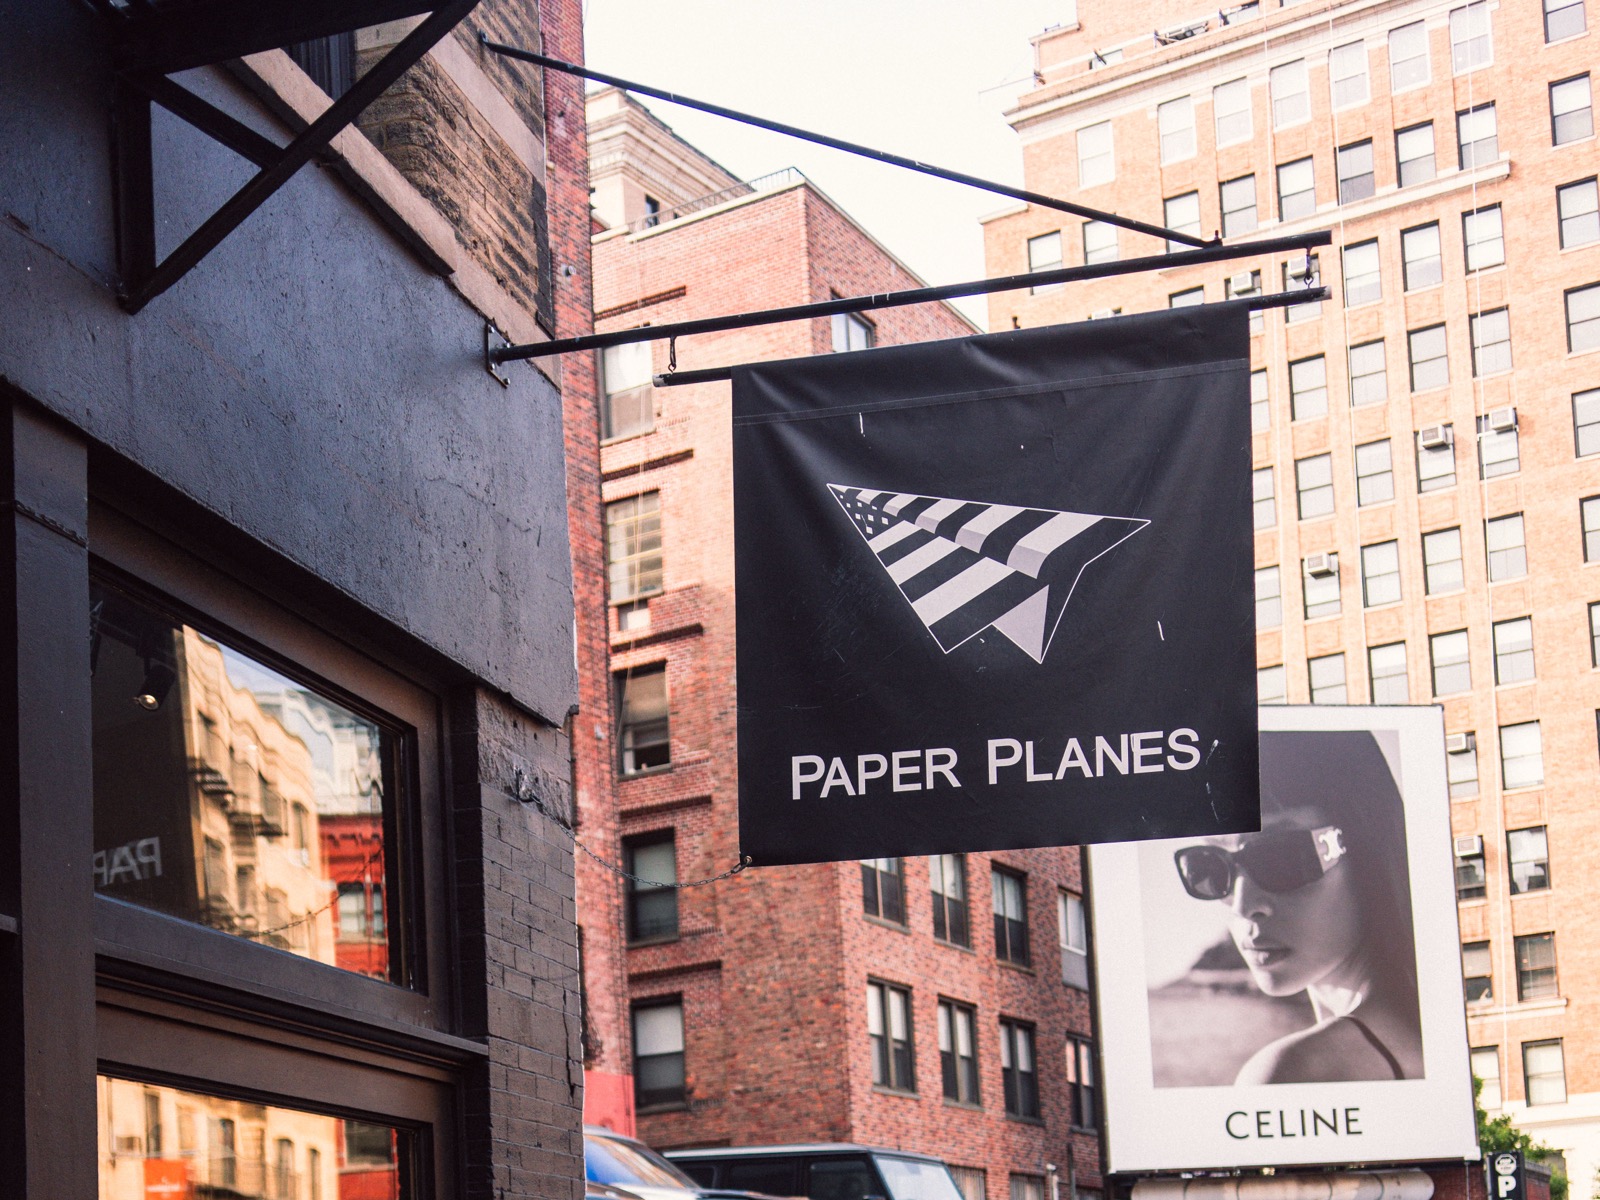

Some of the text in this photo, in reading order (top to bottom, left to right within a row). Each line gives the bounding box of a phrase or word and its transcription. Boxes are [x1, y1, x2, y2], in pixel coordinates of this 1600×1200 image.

[791, 727, 1201, 801] PAPER PLANES
[1225, 1107, 1363, 1140] CELINE
